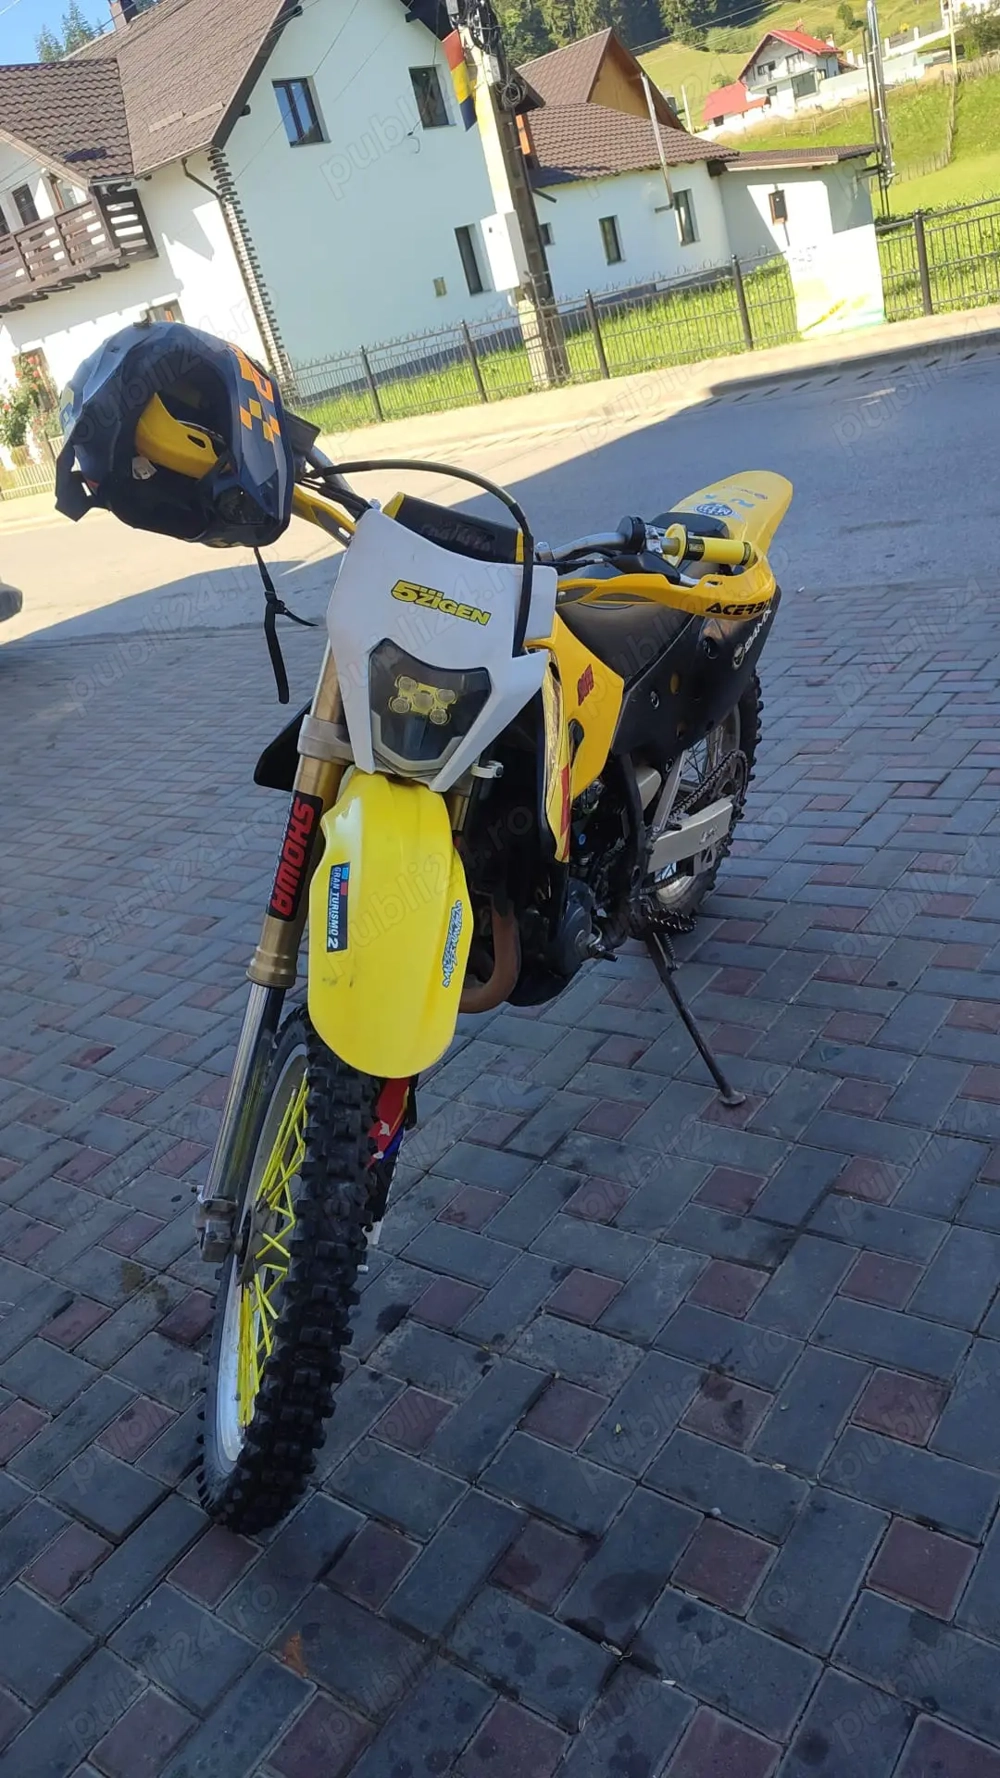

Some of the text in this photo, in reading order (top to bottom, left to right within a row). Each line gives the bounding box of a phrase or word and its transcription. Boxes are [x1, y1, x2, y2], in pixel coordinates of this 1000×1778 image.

[271, 796, 315, 917] SHOWA
[332, 866, 342, 889] GRAN
[331, 891, 341, 936] TURISMO
[328, 937, 339, 949] 2
